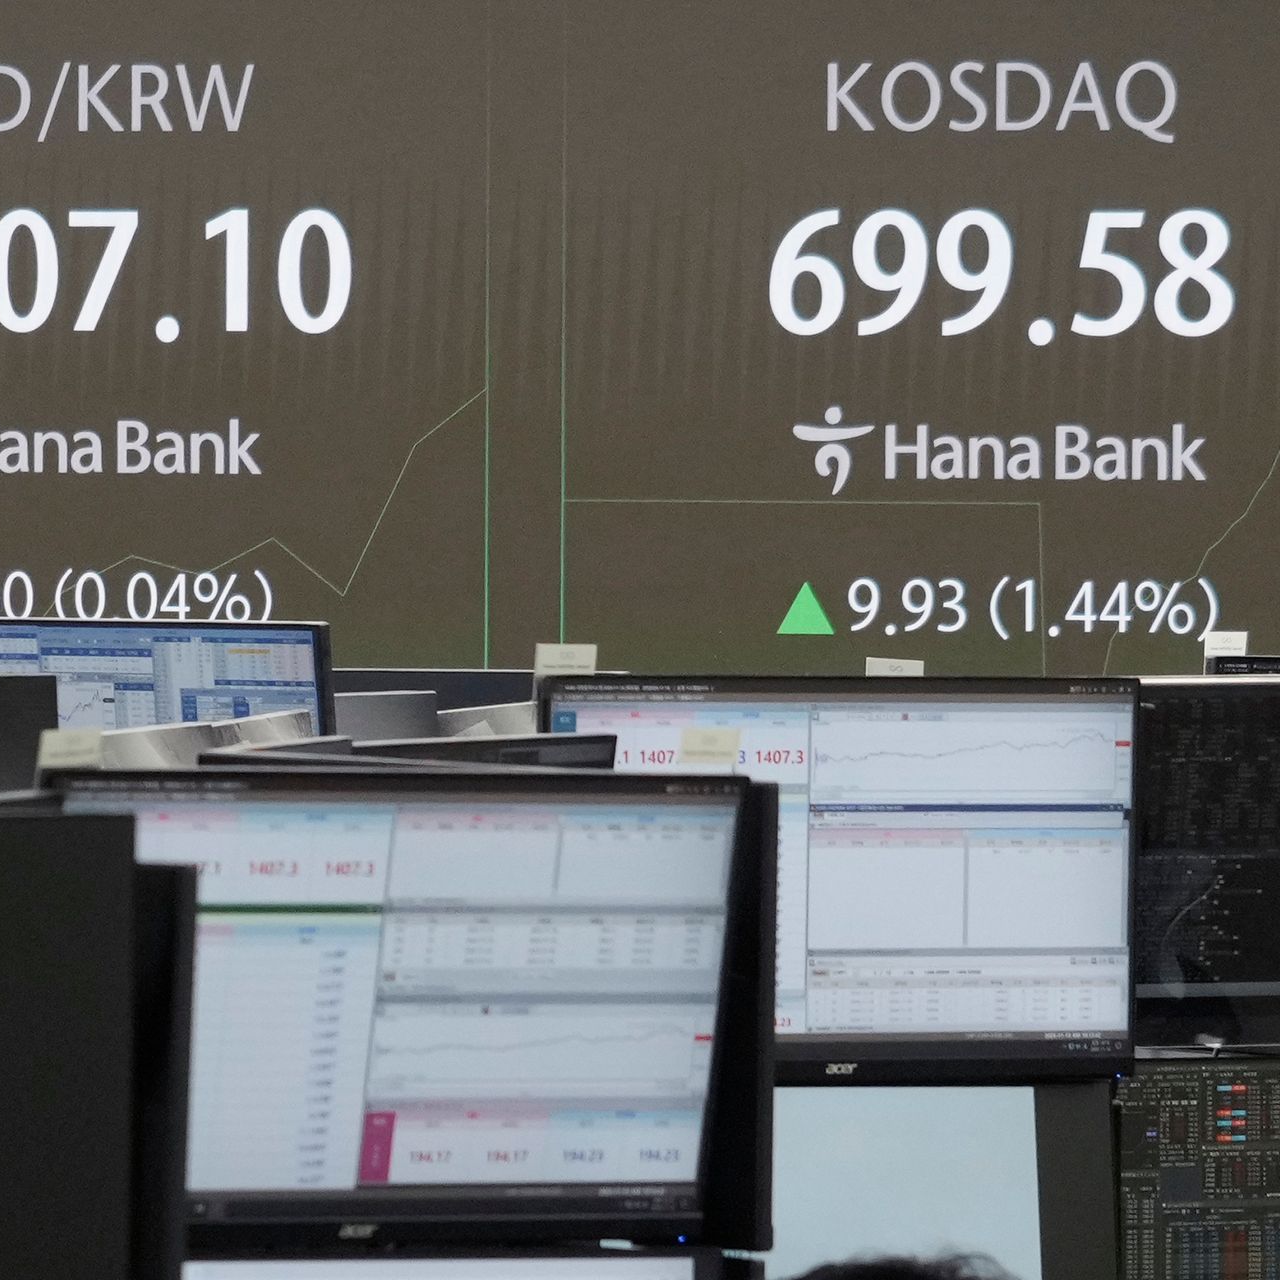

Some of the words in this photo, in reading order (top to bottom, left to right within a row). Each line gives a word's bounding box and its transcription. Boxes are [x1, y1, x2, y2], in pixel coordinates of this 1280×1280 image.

[826, 60, 1178, 144] KOSDAQ
[768, 208, 1236, 347] 699.58
[116, 419, 262, 476] Bank
[884, 424, 1041, 481] Hana
[1054, 424, 1207, 482] Bank
[55, 567, 273, 622] (004%)
[847, 576, 968, 637] 9.93
[989, 576, 1220, 642] (1.44%)
[639, 749, 680, 765] 1407.
[755, 749, 804, 765] 1407.3
